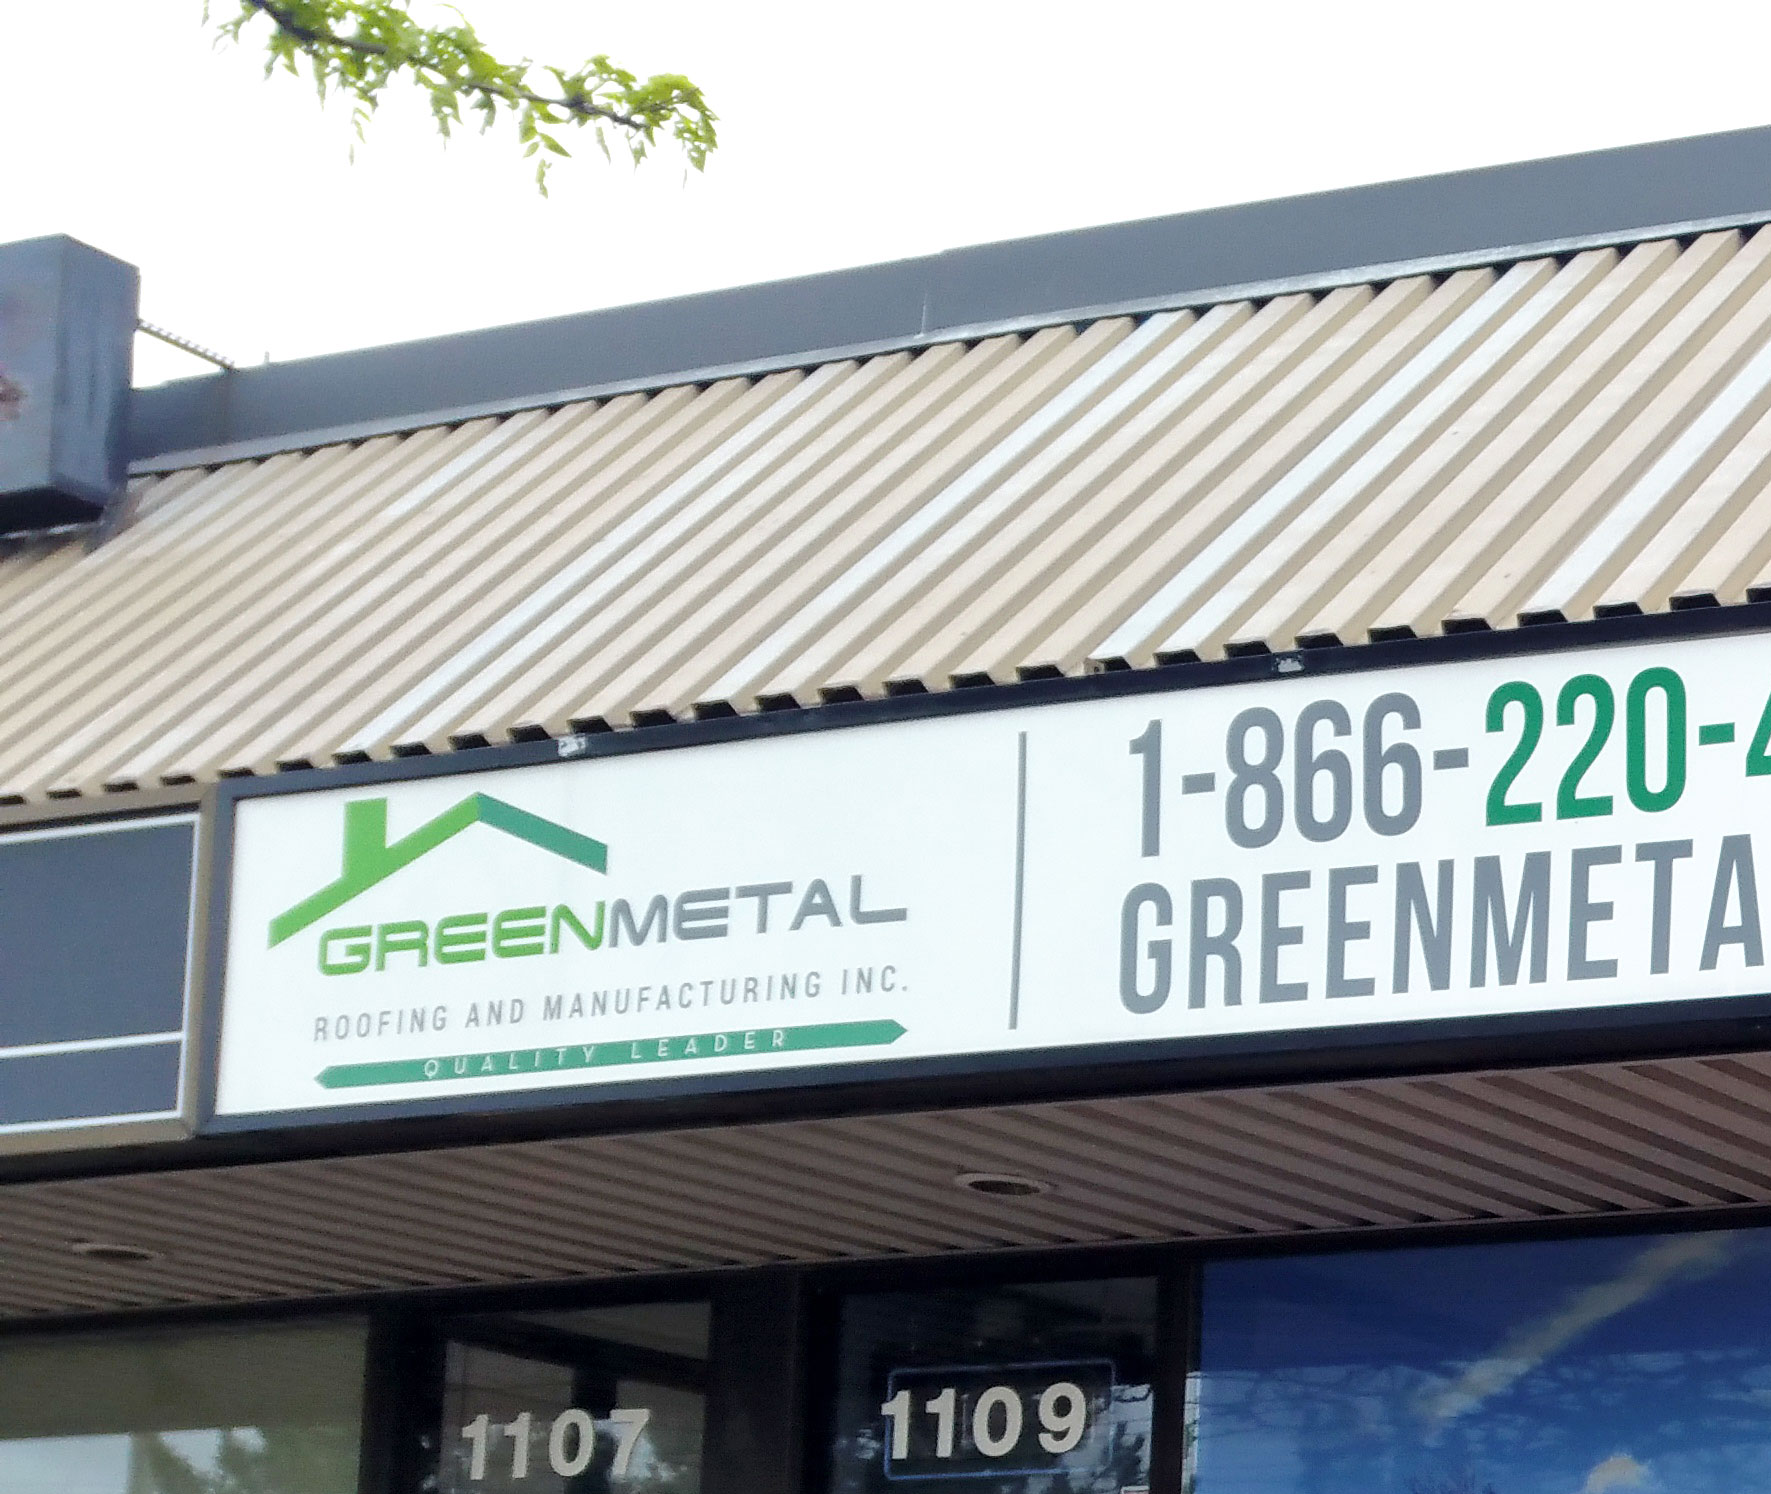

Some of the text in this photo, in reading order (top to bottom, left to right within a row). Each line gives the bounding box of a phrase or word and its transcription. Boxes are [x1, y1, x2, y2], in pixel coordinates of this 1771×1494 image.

[319, 874, 909, 976] GREENMETAL
[313, 965, 910, 1041] ROOFING AND MANUFACTURING INC.
[423, 1029, 788, 1080] QUALITY LEADER
[461, 1408, 652, 1481] 1107
[881, 1382, 1087, 1460] 1109
